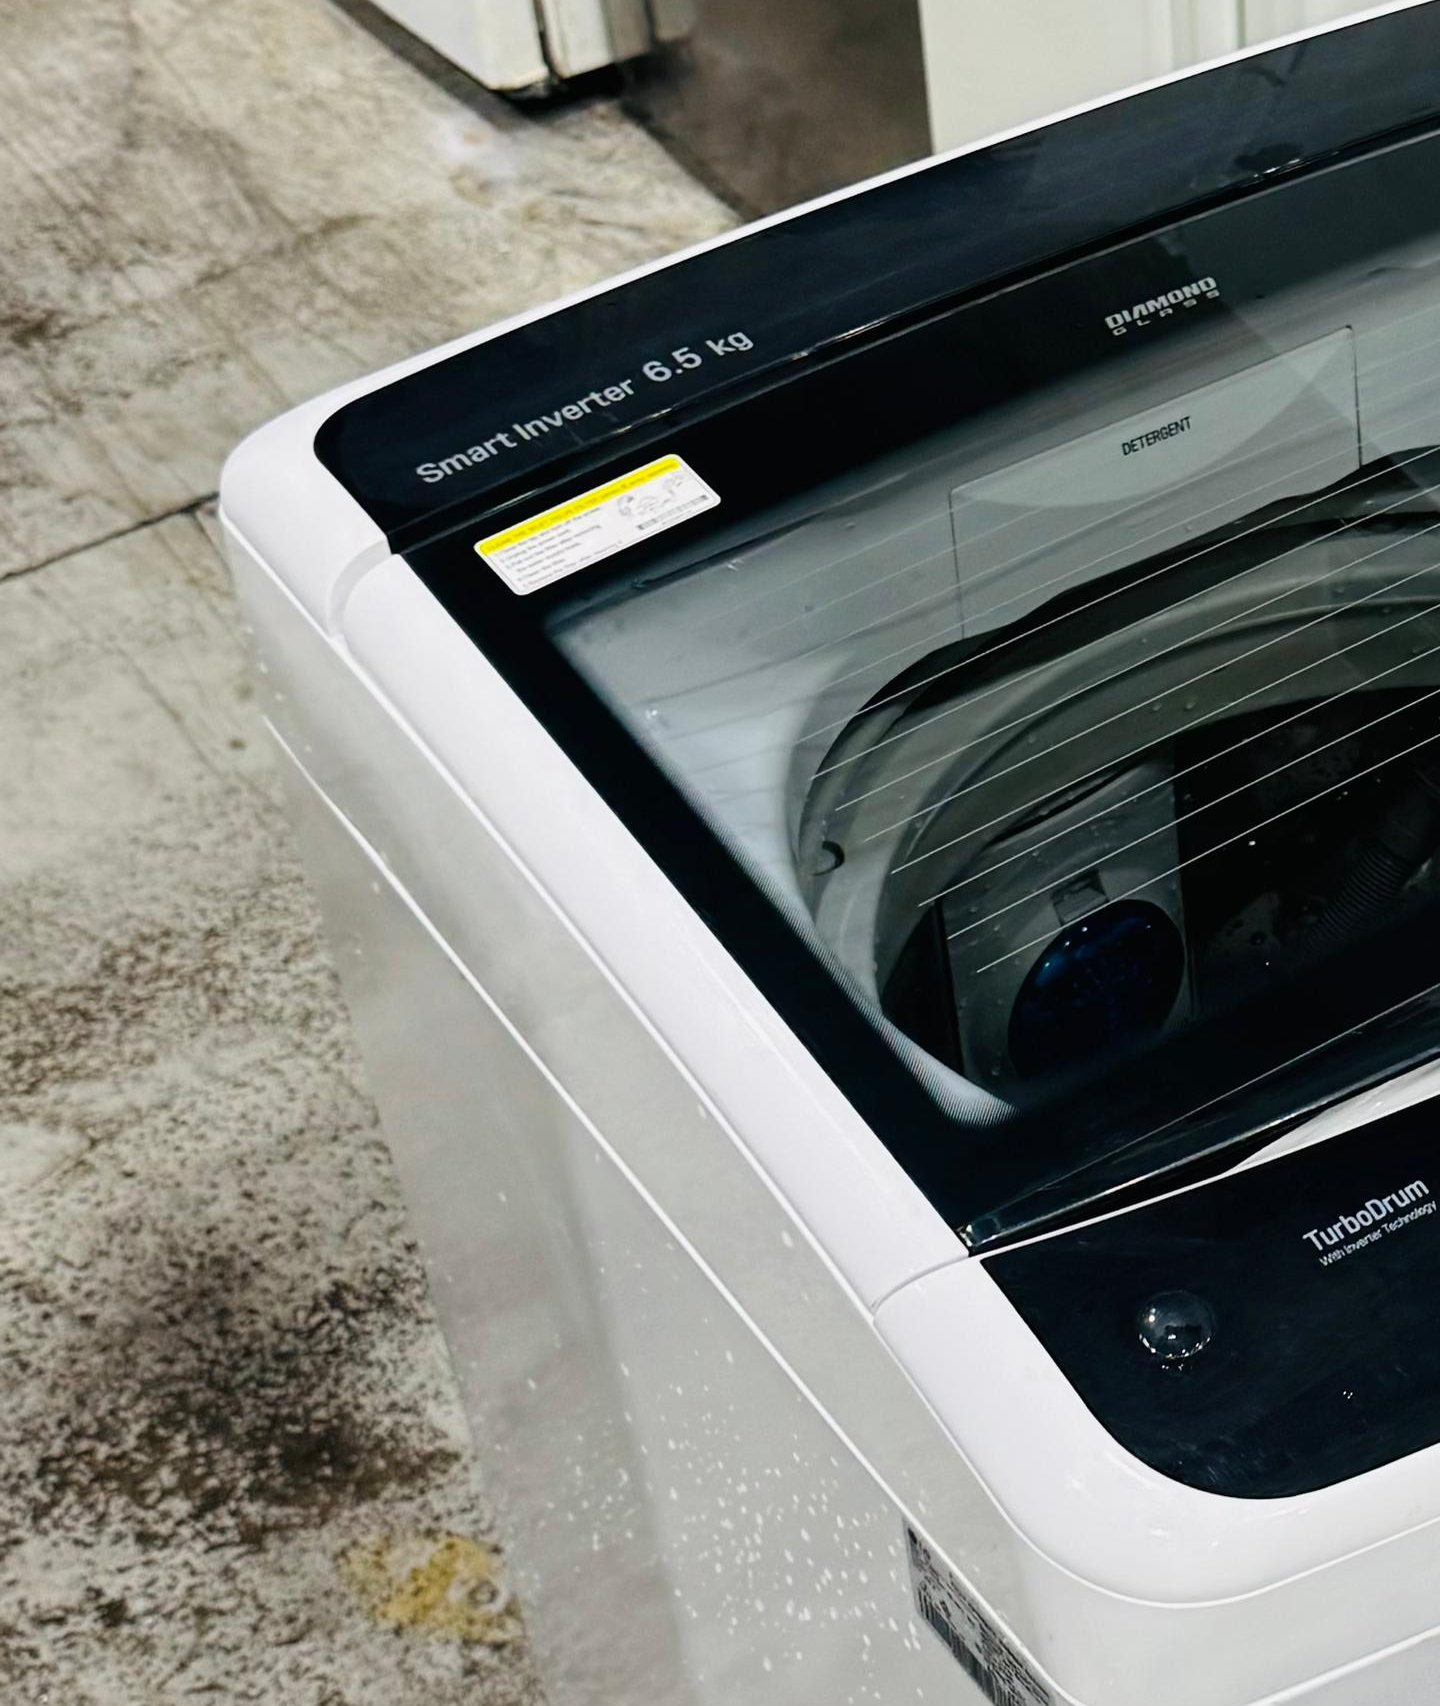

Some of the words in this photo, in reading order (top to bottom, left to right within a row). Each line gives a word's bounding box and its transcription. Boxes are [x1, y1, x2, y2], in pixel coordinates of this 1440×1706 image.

[1104, 276, 1217, 330] DIAMOND
[415, 431, 518, 483] Smart
[512, 378, 636, 441] Inverter
[642, 346, 703, 383] 6.5
[705, 331, 755, 357] kg
[1121, 415, 1192, 456] DETERGENT
[1302, 1180, 1430, 1251] TurboDrum
[1318, 1249, 1346, 1266] With
[1381, 1200, 1437, 1233] Technology
